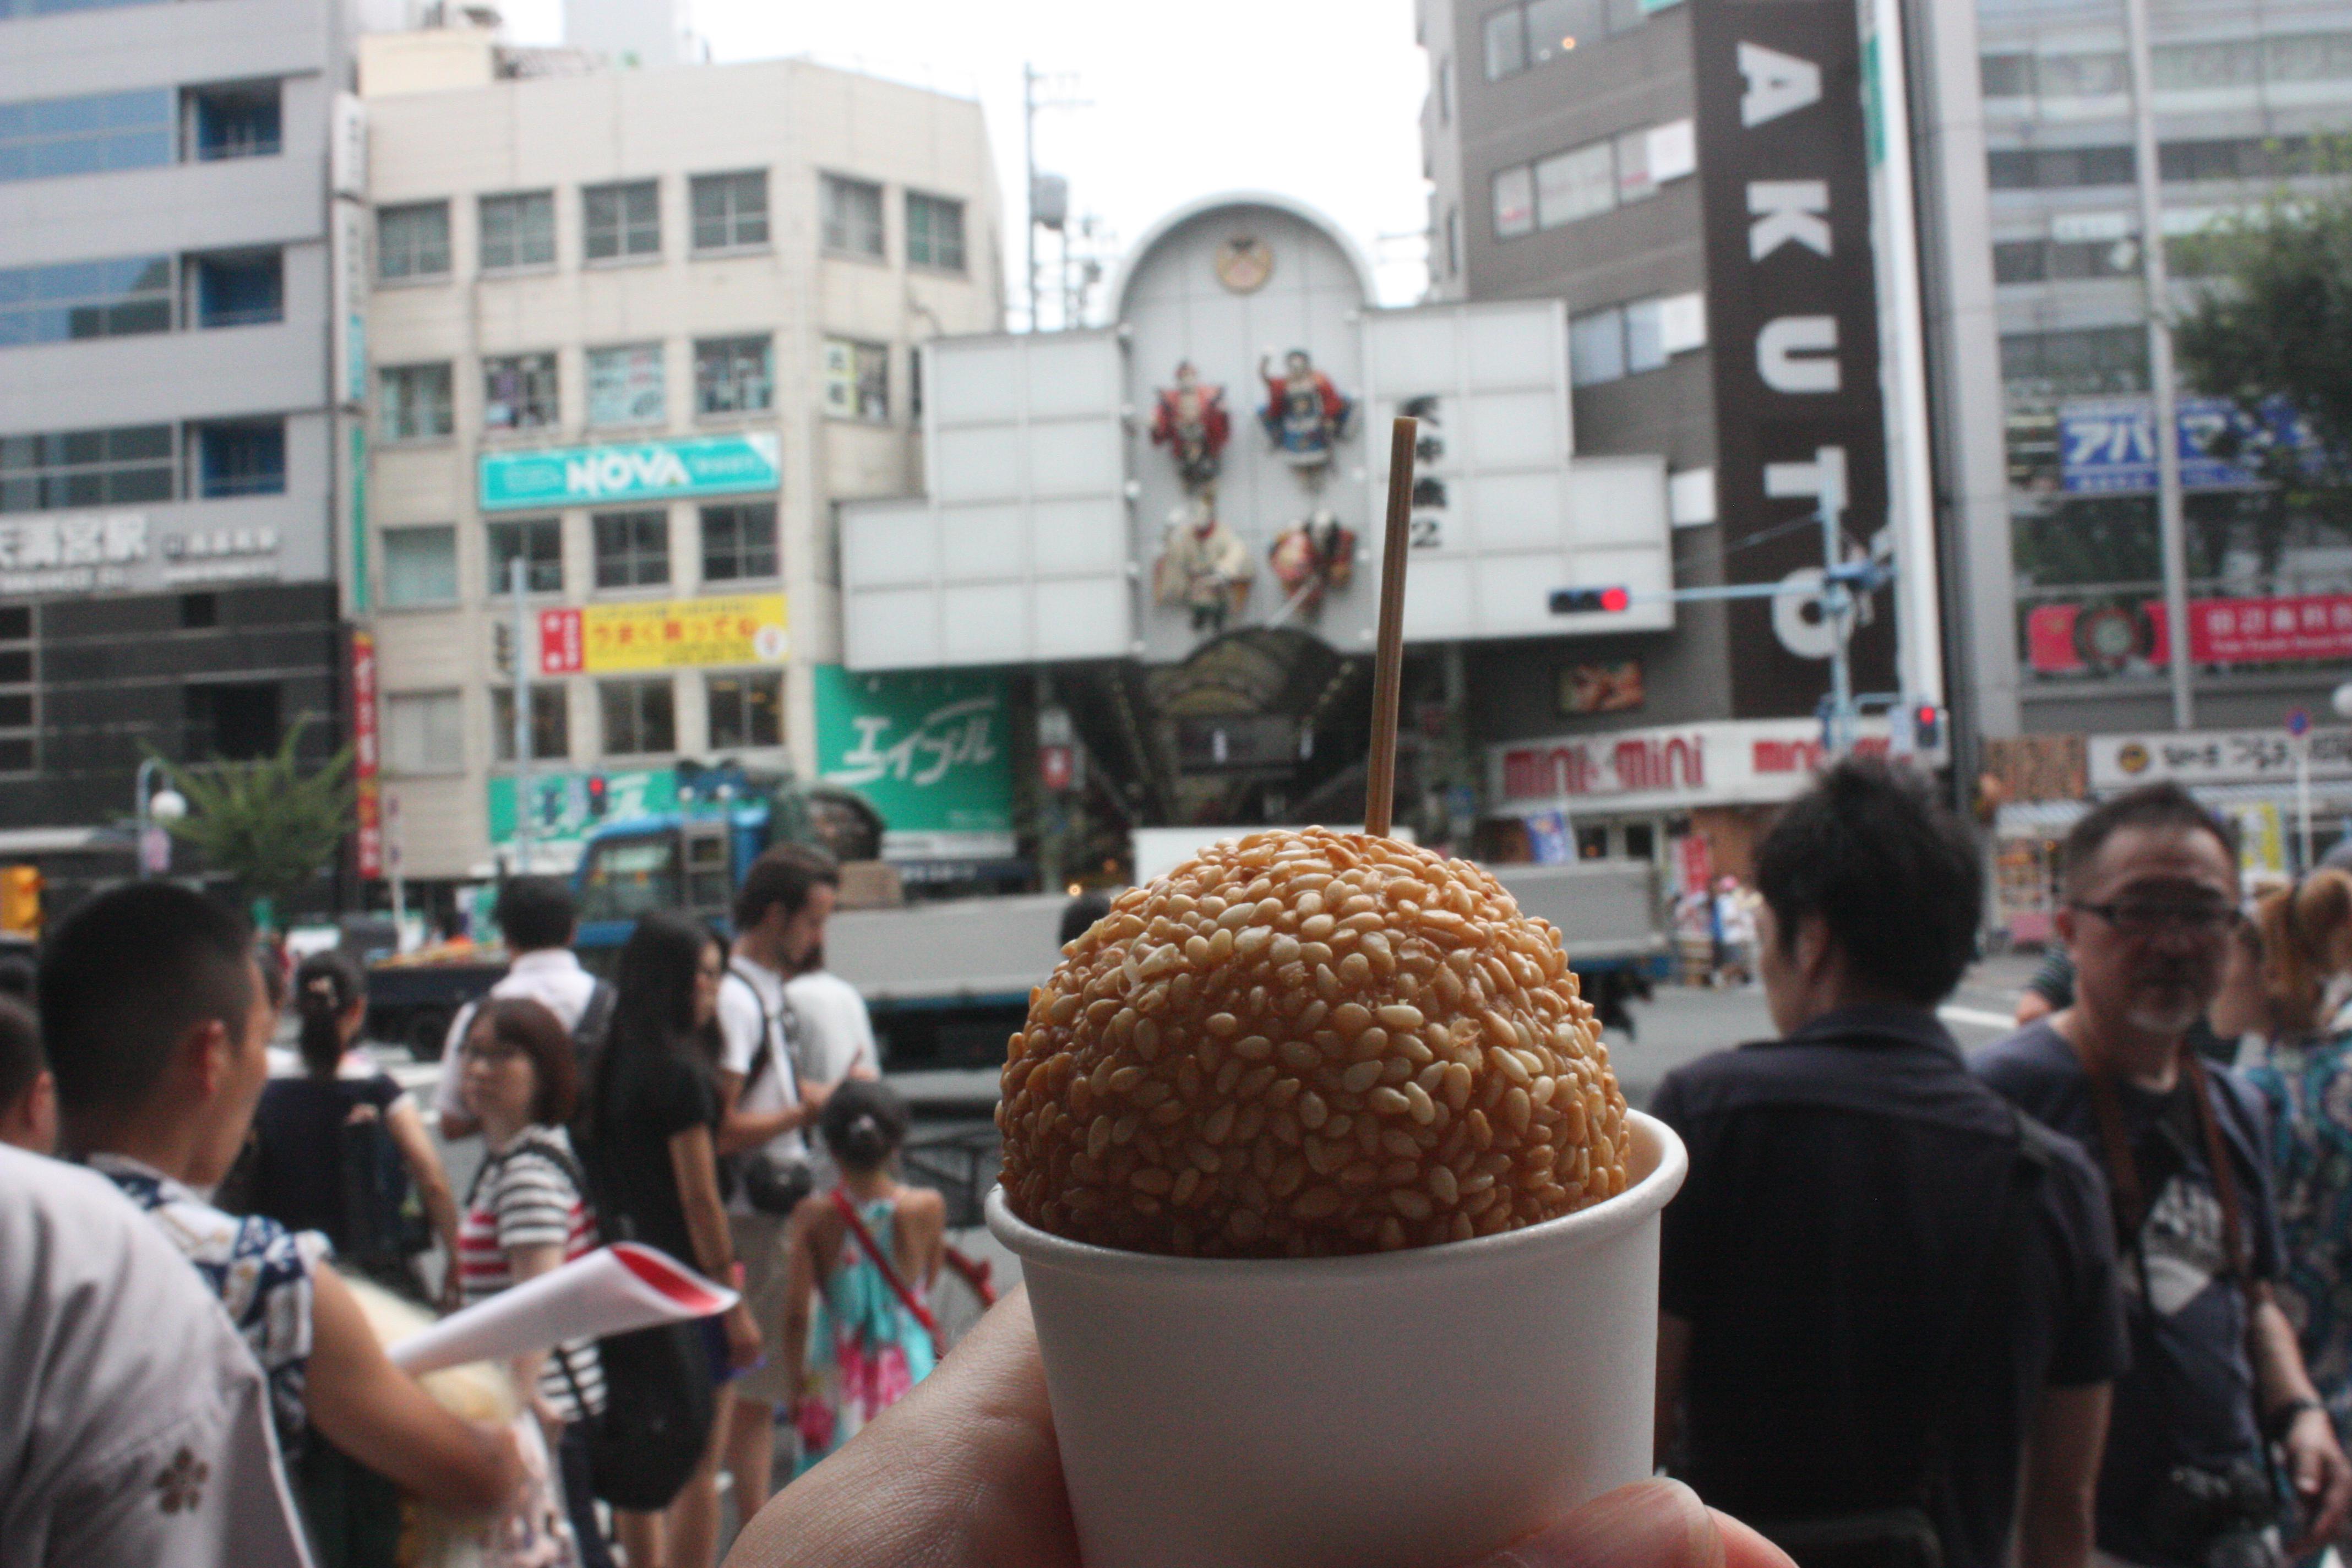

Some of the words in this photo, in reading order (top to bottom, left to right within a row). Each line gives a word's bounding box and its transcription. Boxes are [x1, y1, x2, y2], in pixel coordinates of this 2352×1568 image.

[565, 450, 690, 496] NOVA
[829, 698, 997, 785] エイブル
